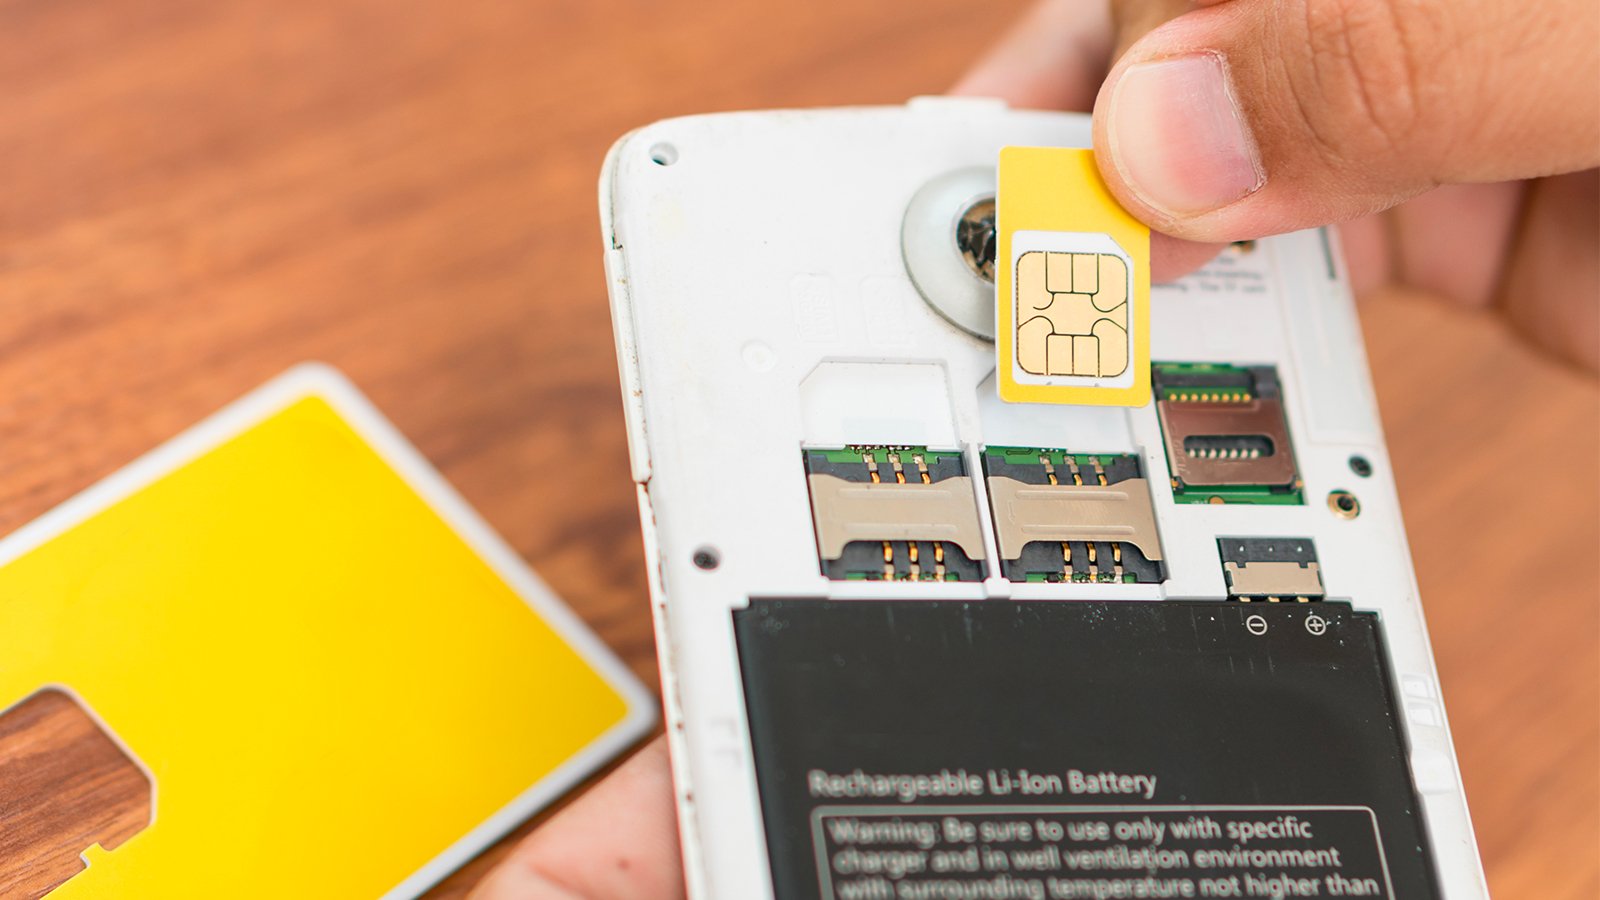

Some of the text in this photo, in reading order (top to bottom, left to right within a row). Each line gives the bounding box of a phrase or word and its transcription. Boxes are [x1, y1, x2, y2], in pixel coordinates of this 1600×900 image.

[808, 769, 1157, 803] Rechargeable Li-Ion Battery
[827, 816, 1313, 849] Warning: Be sure to use only with specific
[833, 844, 1342, 879] charger and in well ventilation environment
[836, 876, 895, 900] with
[1047, 876, 1195, 900] temperature
[1200, 875, 1243, 897] not
[1245, 872, 1320, 900] higher
[1325, 872, 1380, 897] than
